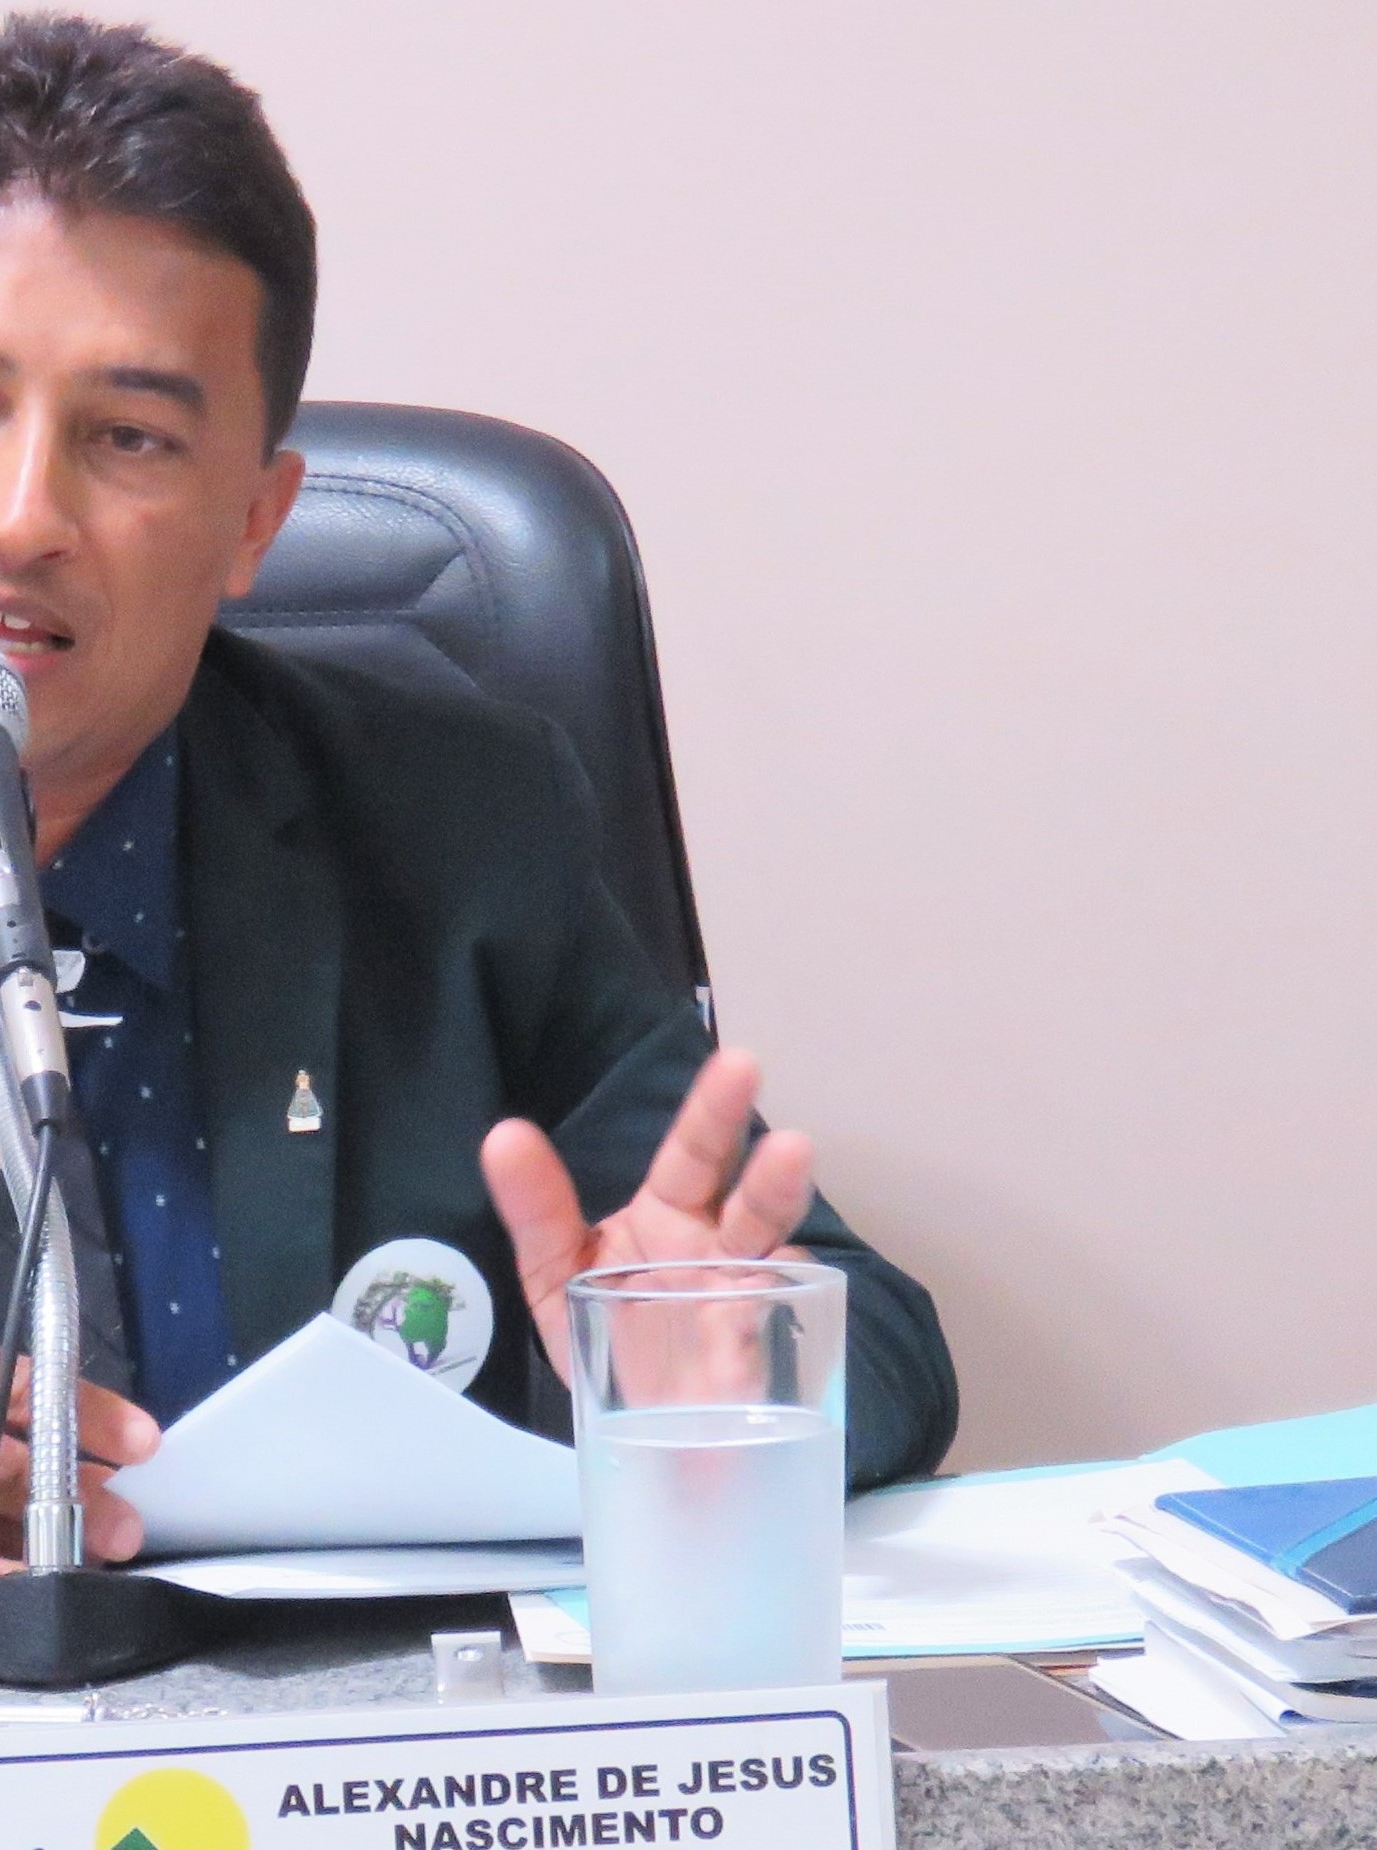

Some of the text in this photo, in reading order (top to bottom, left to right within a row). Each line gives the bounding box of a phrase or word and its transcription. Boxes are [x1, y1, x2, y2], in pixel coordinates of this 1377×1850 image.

[277, 1754, 837, 1818] ALEXANDRE DE JESUS
[394, 1806, 724, 1850] NASCIMENTO
